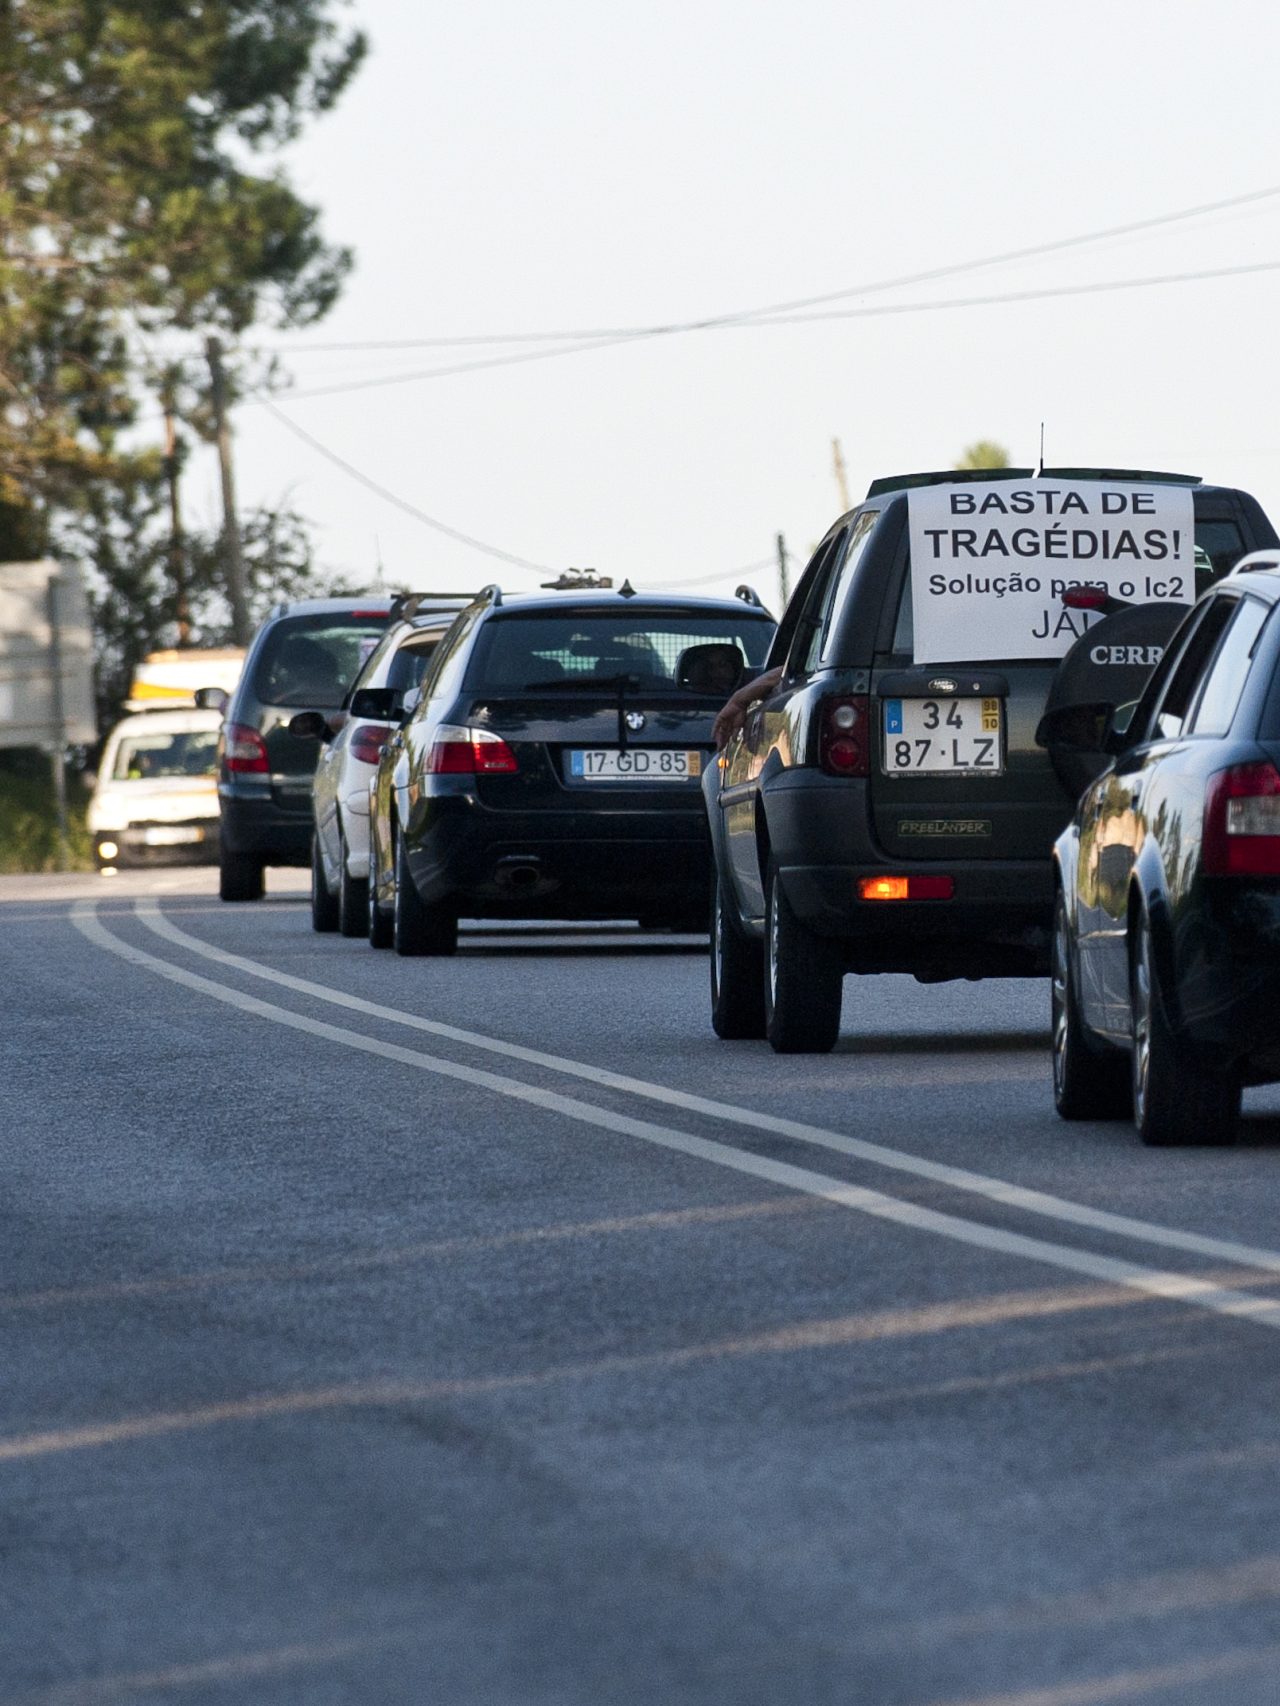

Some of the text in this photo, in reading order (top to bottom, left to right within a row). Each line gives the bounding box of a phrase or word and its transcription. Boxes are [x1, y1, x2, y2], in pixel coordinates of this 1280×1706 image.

[950, 490, 1157, 515] BASTA DE
[924, 522, 1181, 561] TRAGÉDIAS!
[928, 572, 1042, 599] Solução
[1119, 581, 1136, 597] o
[891, 720, 898, 729] P
[922, 701, 963, 730] 34
[984, 718, 998, 729] 10
[900, 822, 987, 834] FREELANDER
